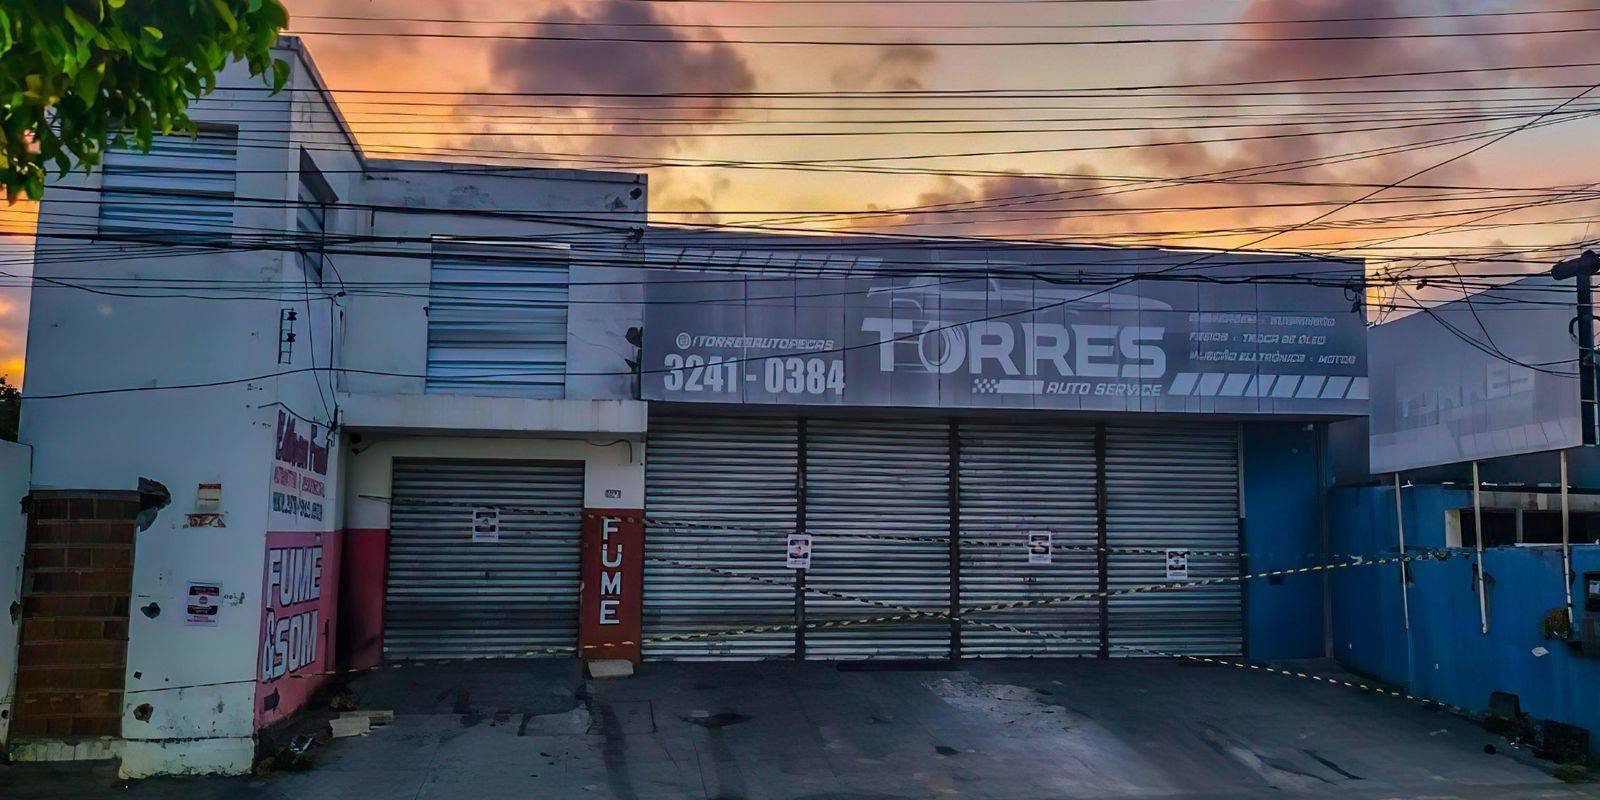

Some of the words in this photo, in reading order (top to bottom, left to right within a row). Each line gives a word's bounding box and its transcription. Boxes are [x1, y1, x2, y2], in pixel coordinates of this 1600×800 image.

[663, 353, 737, 394] 3241
[764, 357, 846, 396] 0384
[861, 317, 1167, 379] TORRES
[1046, 381, 1091, 395] AUTO
[1094, 383, 1163, 397] SERVICE
[266, 545, 323, 611] FUME
[599, 515, 623, 625] FUME
